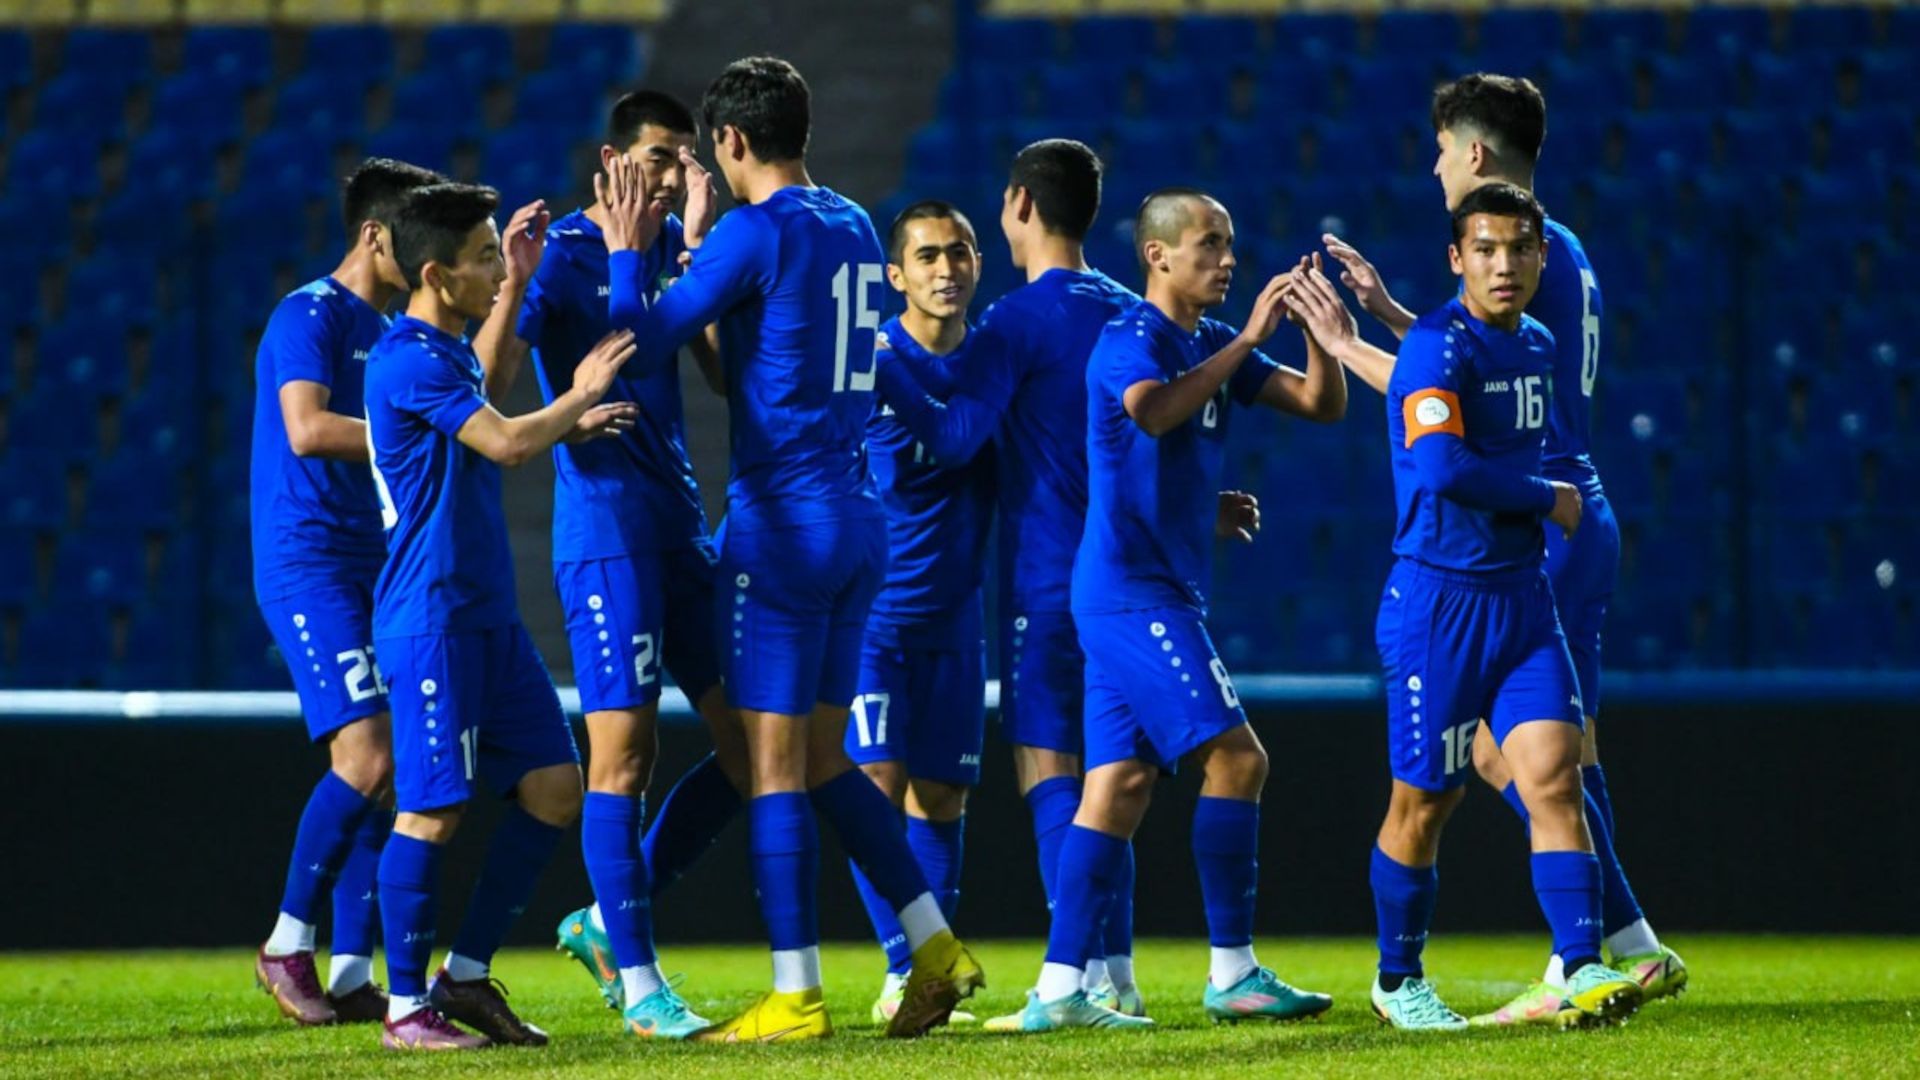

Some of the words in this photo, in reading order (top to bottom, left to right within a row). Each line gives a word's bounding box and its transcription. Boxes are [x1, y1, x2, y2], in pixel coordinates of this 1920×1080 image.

[831, 261, 884, 393] 15
[1579, 267, 1600, 397] 6
[1482, 380, 1510, 394] JAKO
[1513, 375, 1544, 430] 16
[1208, 657, 1241, 709] 8
[850, 693, 890, 748] 17
